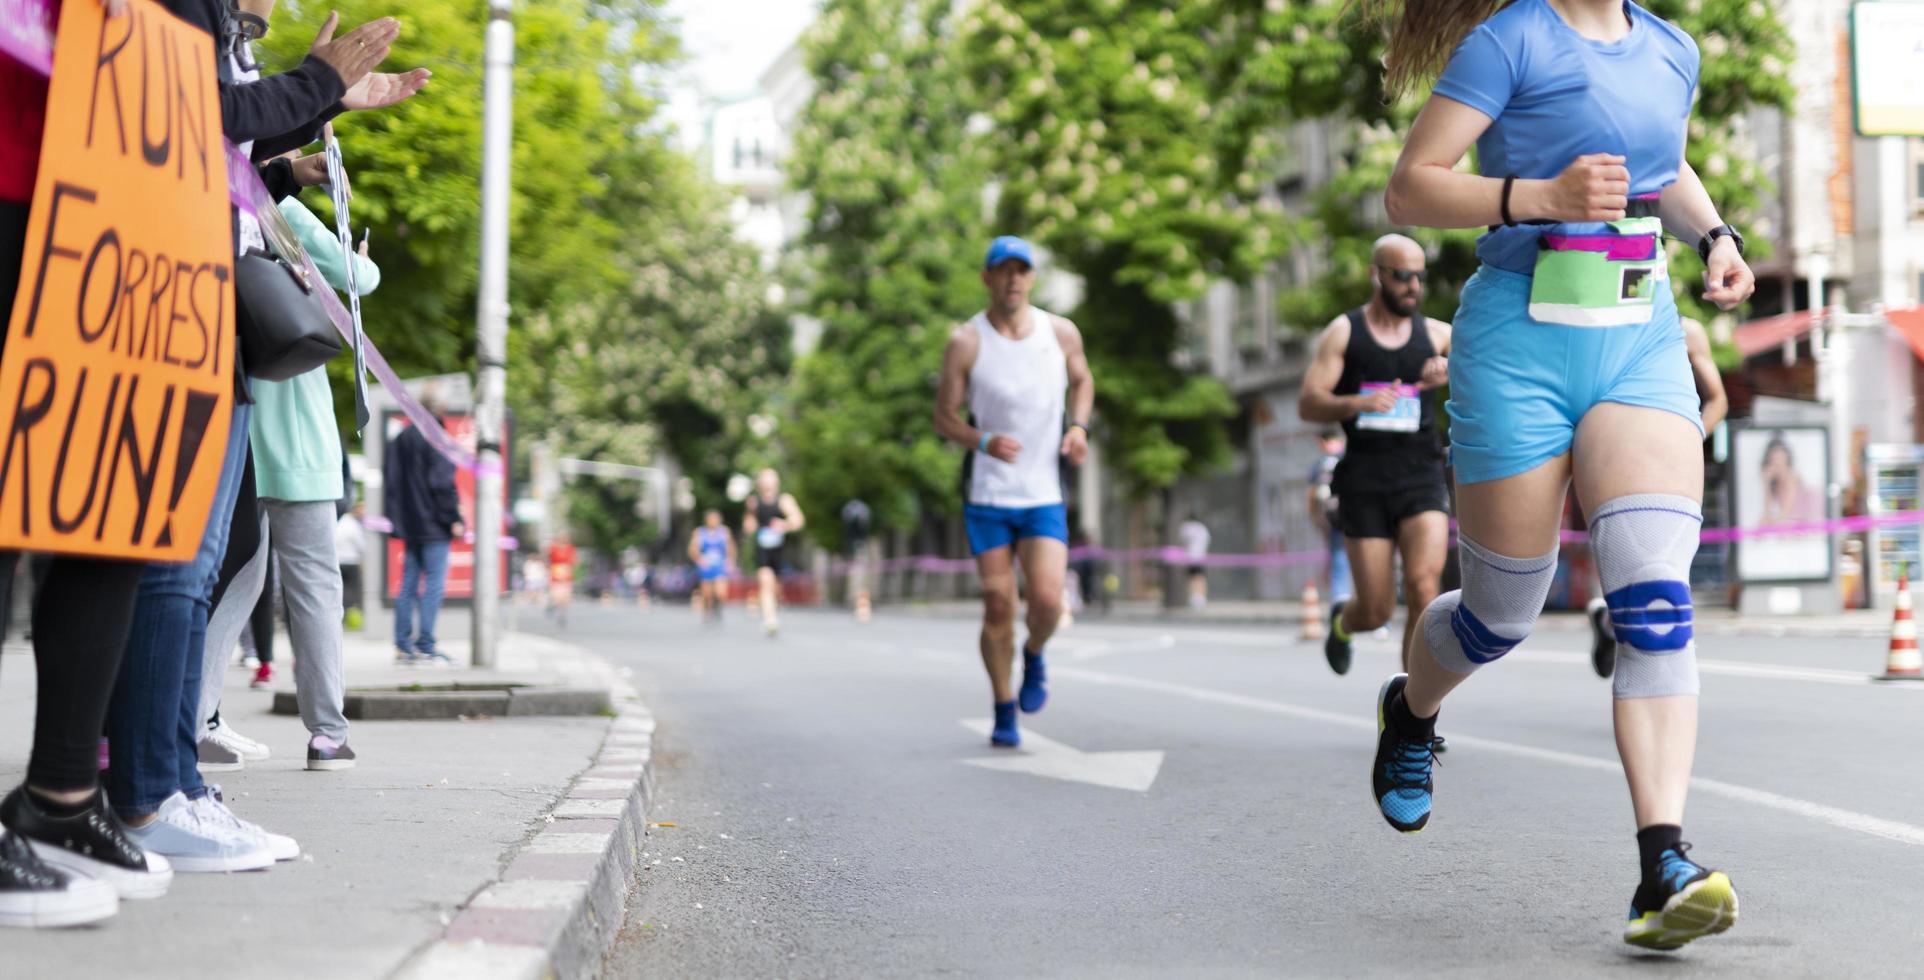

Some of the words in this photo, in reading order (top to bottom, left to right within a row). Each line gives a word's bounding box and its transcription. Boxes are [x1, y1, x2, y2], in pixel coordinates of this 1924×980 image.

[86, 2, 209, 191] RUN
[25, 182, 230, 375] FORREST
[0, 358, 219, 547] RUN!
